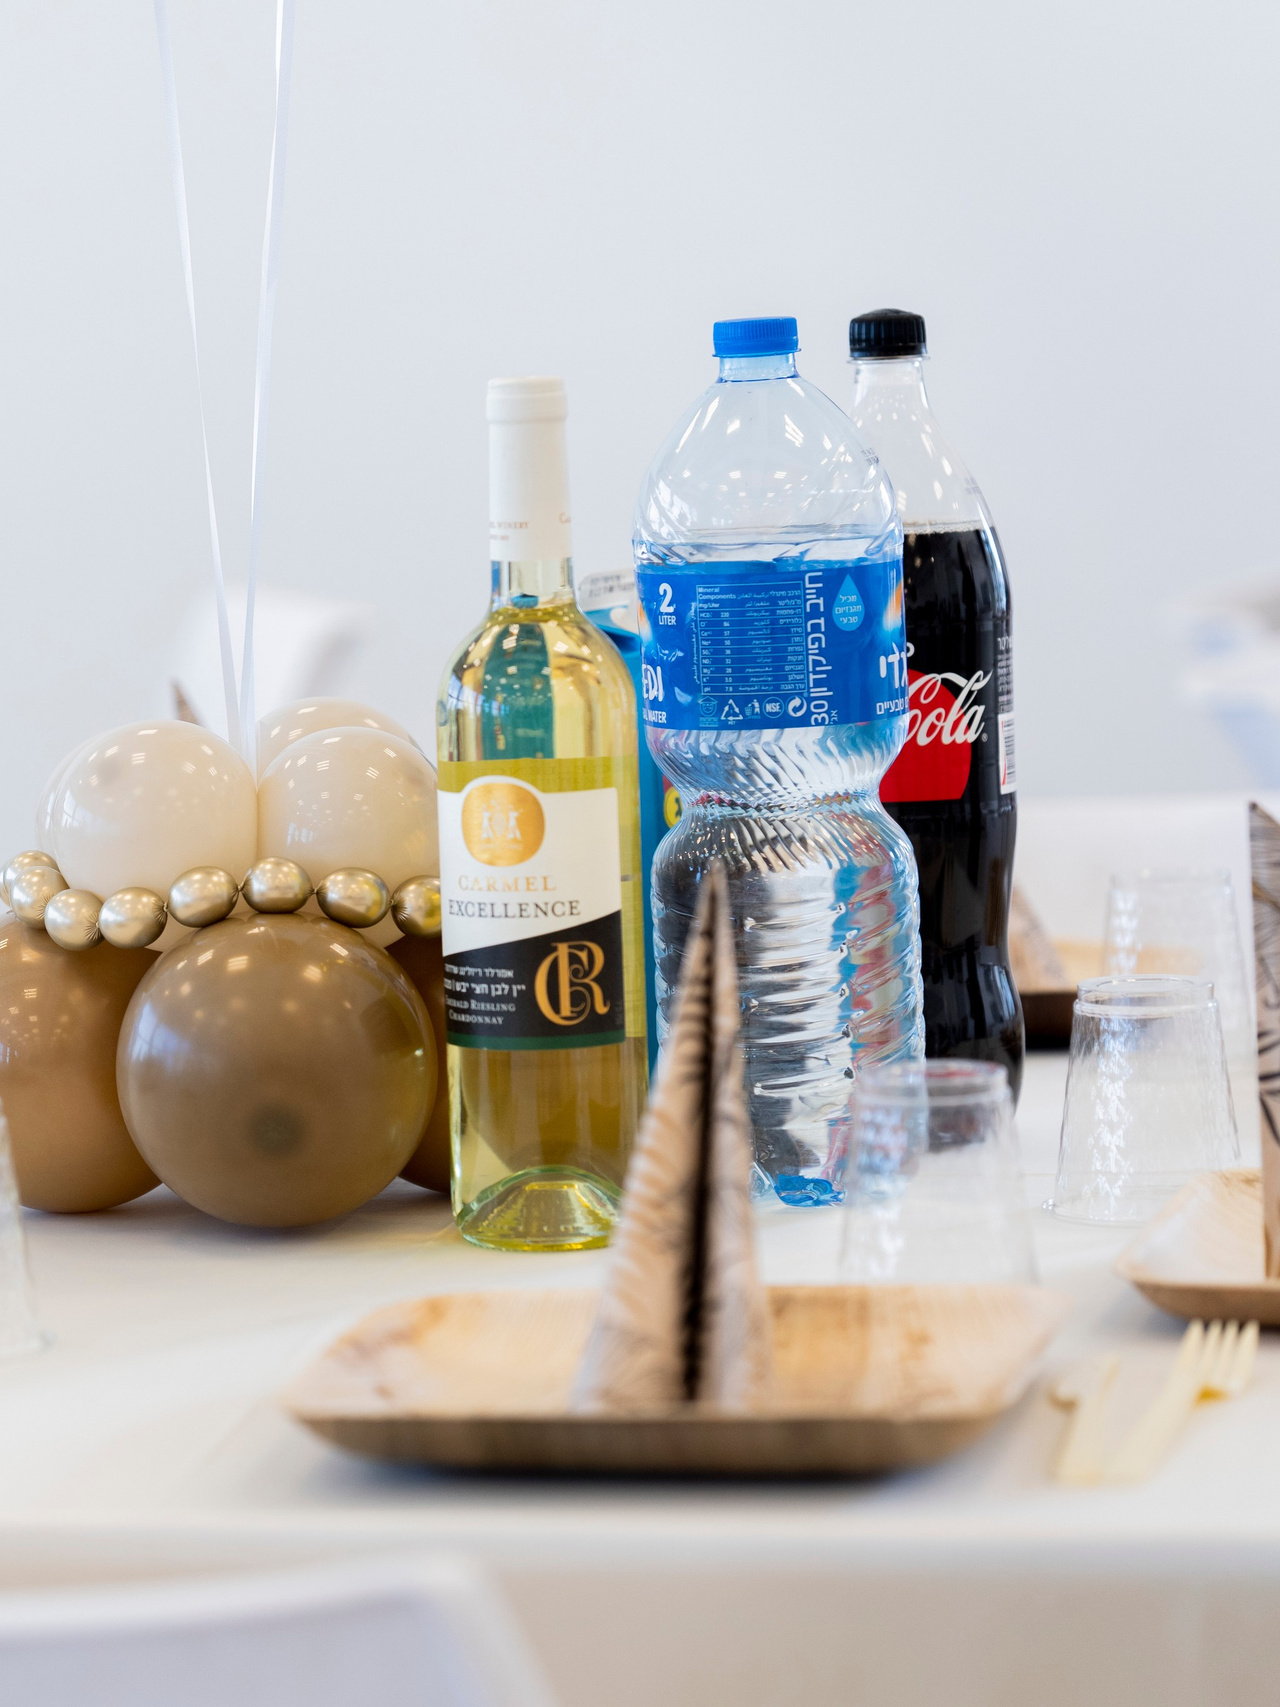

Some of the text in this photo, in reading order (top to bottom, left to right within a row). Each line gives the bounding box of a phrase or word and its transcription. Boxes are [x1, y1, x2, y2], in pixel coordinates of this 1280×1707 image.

[659, 583, 674, 613] 2
[805, 572, 824, 612] חייב
[840, 594, 856, 602] מכיל
[835, 604, 862, 614] מגנזיום
[658, 615, 676, 626] LITER
[840, 616, 858, 624] טבעי
[807, 617, 833, 697] בפיקדון
[907, 669, 994, 746] Cola
[648, 709, 667, 724] WATER
[458, 874, 557, 892] CARMEL
[448, 899, 581, 918] EXCELLENCE
[490, 982, 509, 998] לבן
[512, 984, 526, 998] יין
[470, 999, 516, 1012] RIESLING
[448, 1009, 504, 1025] CHARDONNAY
